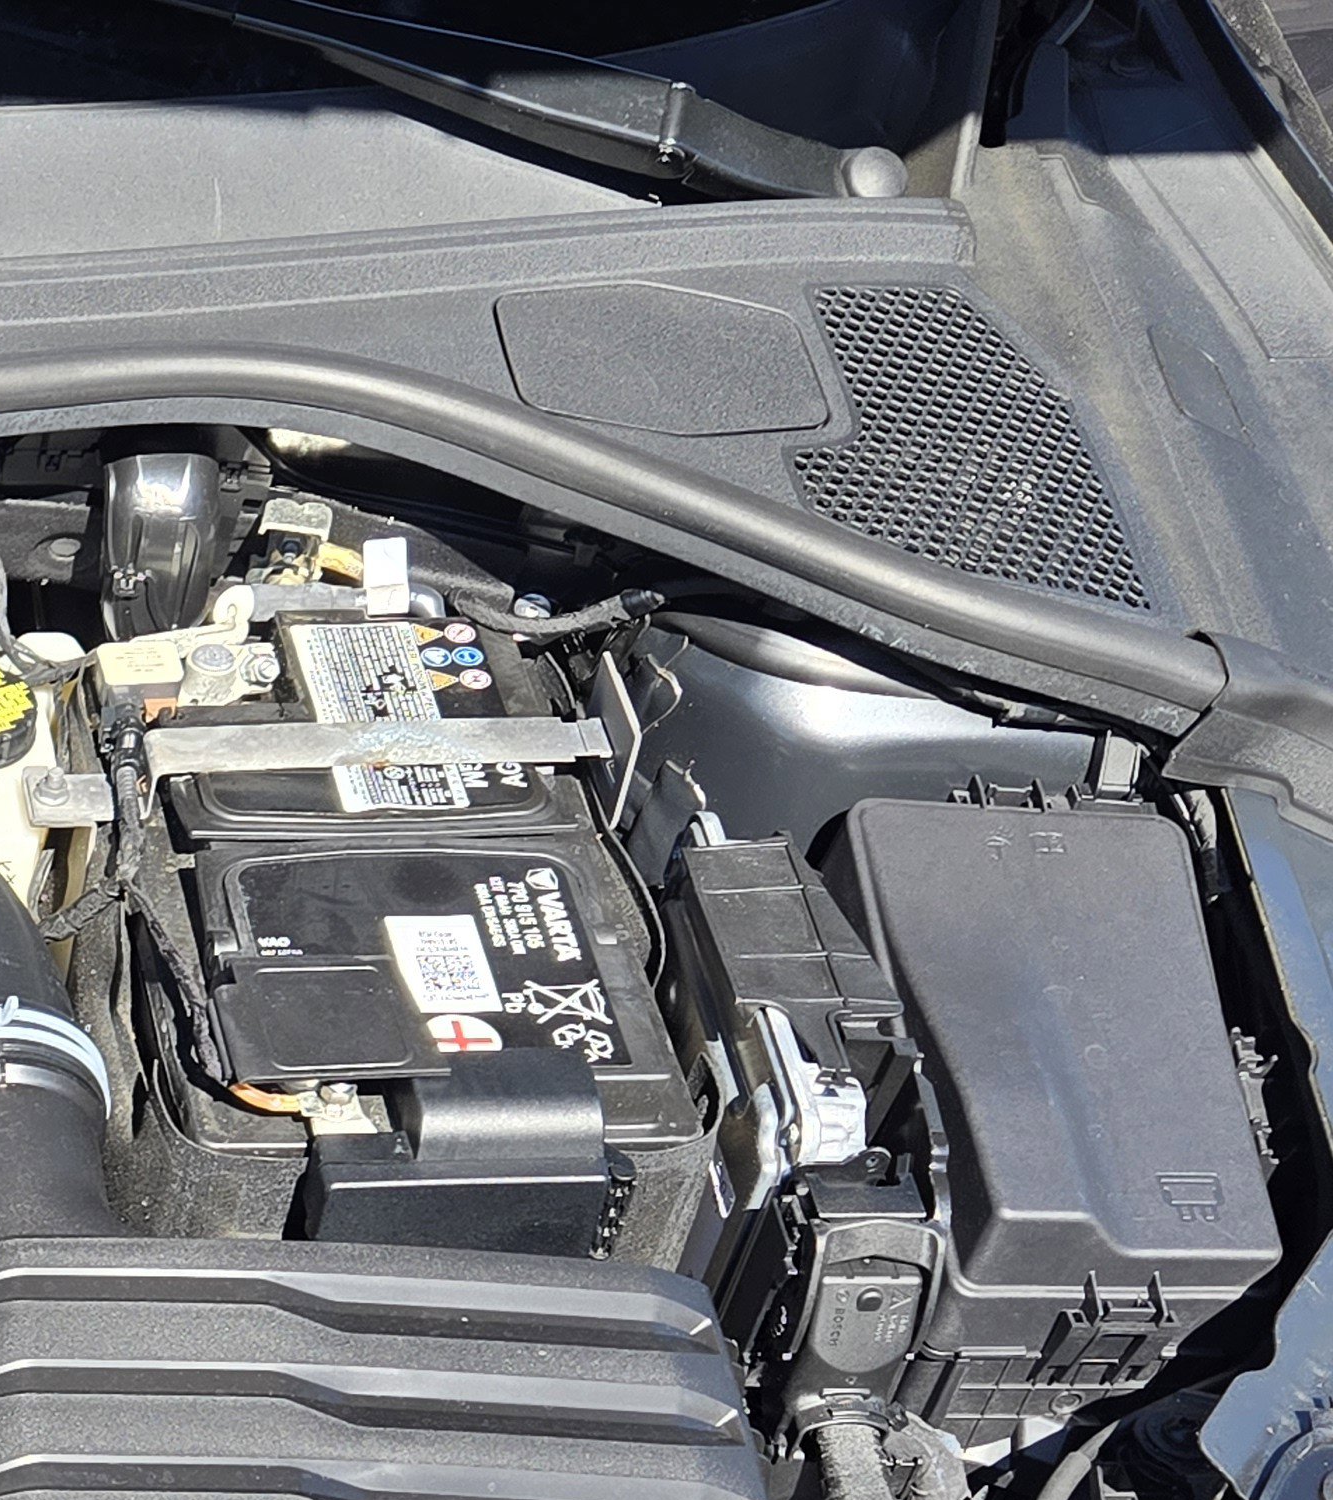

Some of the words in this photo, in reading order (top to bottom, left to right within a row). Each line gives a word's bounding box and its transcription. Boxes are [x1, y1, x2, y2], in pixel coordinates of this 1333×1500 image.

[514, 904, 537, 925] 915
[537, 891, 581, 961] VARTA
[501, 992, 528, 1013] Pb
